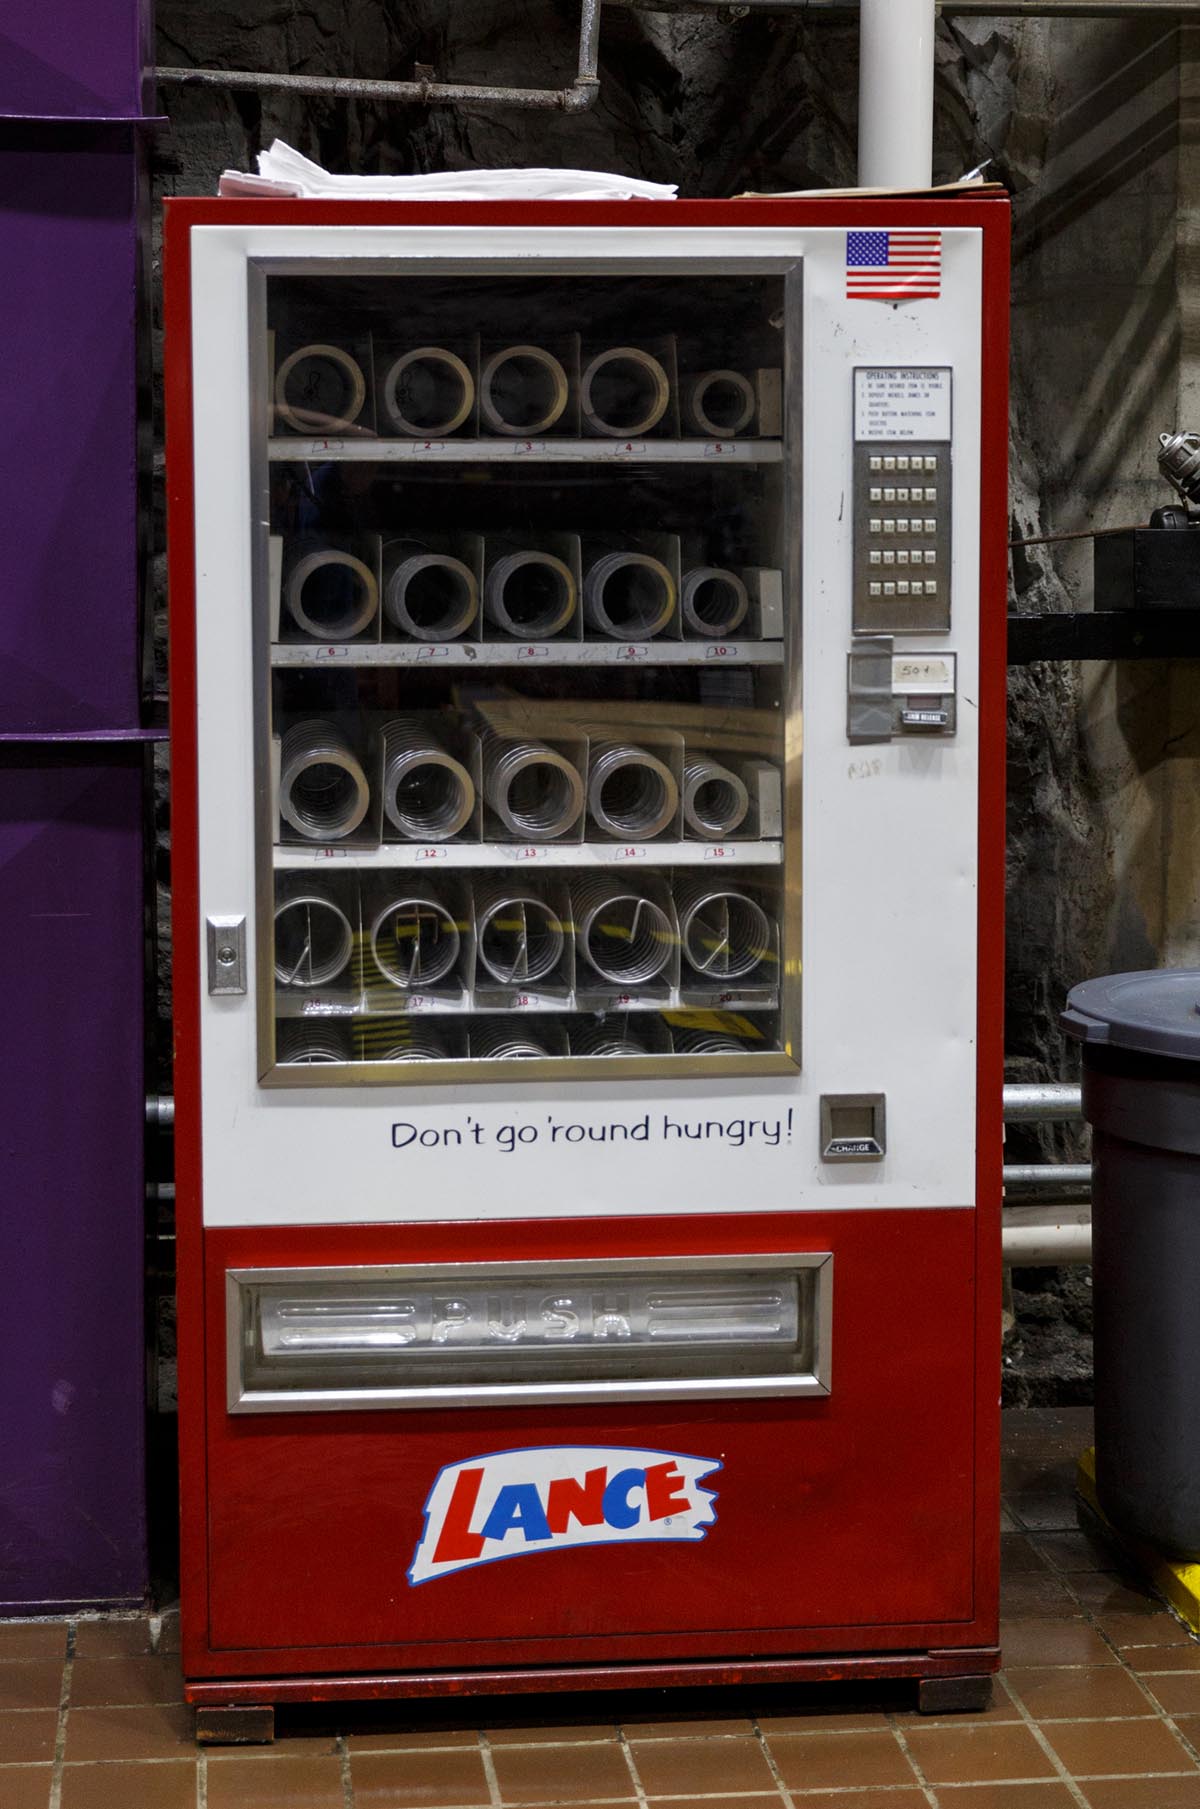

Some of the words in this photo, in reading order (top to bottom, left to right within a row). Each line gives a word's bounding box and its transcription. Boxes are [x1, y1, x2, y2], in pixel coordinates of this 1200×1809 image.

[866, 371, 897, 381] OPERATING
[900, 371, 940, 381] INSTRUCTIONS
[322, 441, 328, 449] 1
[424, 442, 431, 450] 2
[525, 443, 532, 451] 3
[625, 444, 632, 452] 4
[715, 445, 722, 453] 5
[328, 648, 335, 656] 6
[428, 648, 435, 656] 7
[527, 648, 534, 656] 8
[628, 648, 635, 656] 9
[714, 648, 727, 656] 10
[322, 849, 335, 857] 11
[424, 849, 437, 857] 12
[524, 849, 537, 857] 13
[624, 848, 636, 857] 14
[712, 848, 725, 857] 15
[392, 1117, 483, 1147] Don't
[497, 1126, 537, 1152] go
[549, 1116, 649, 1141] 'round
[664, 1109, 792, 1145] hungry!
[836, 1143, 870, 1152] CHANGE
[432, 1295, 633, 1342] PUSH
[431, 1461, 692, 1564] LANCE
